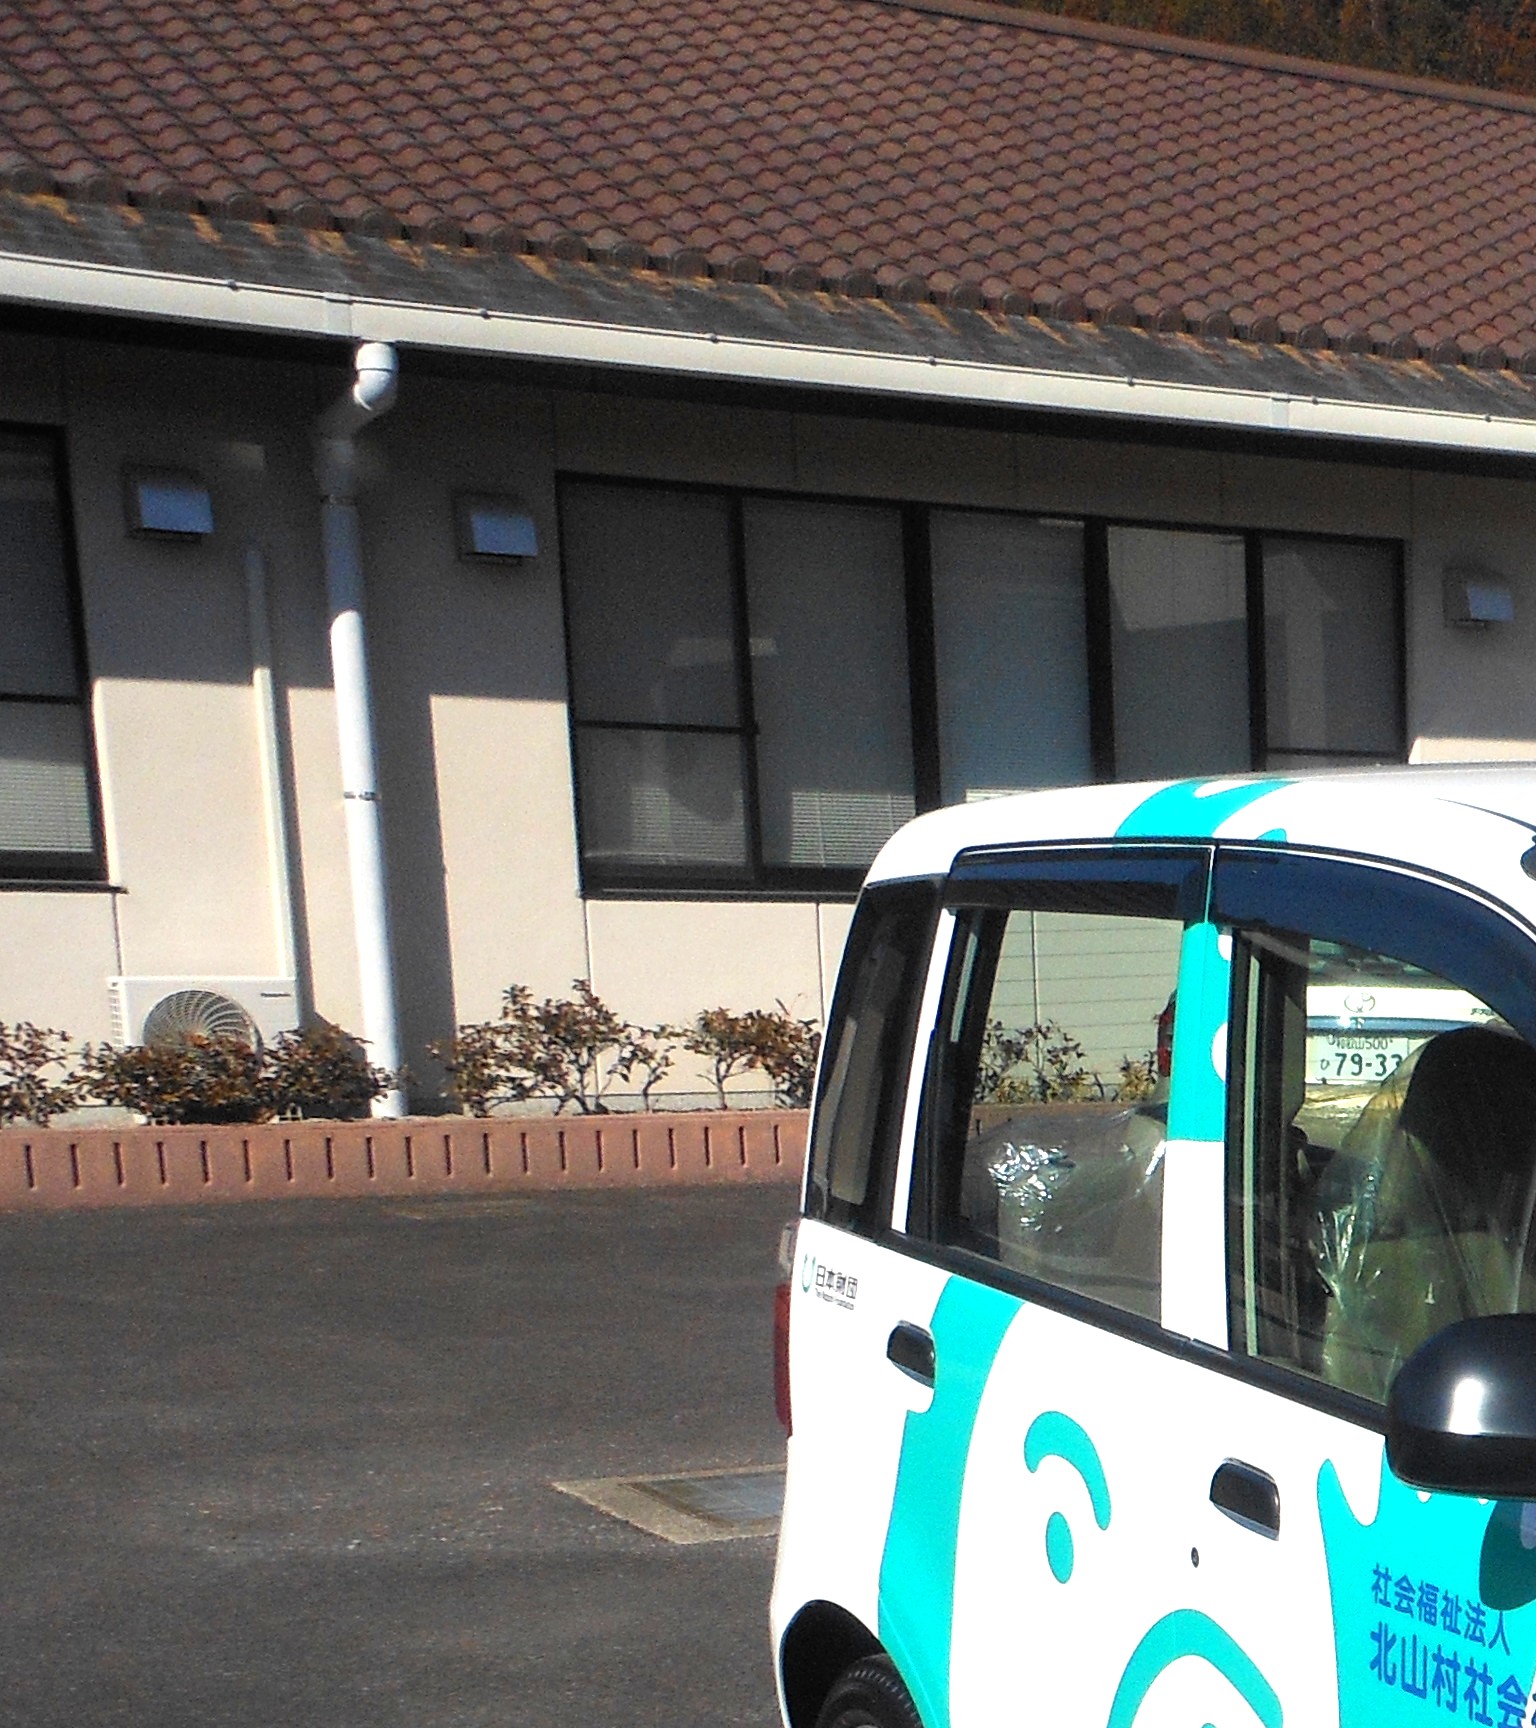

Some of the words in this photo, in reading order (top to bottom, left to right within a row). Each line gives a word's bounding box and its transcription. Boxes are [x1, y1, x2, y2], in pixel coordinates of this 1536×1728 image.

[816, 1265, 858, 1299] 日本財団
[1372, 1563, 1511, 1655] 社会福祉法人
